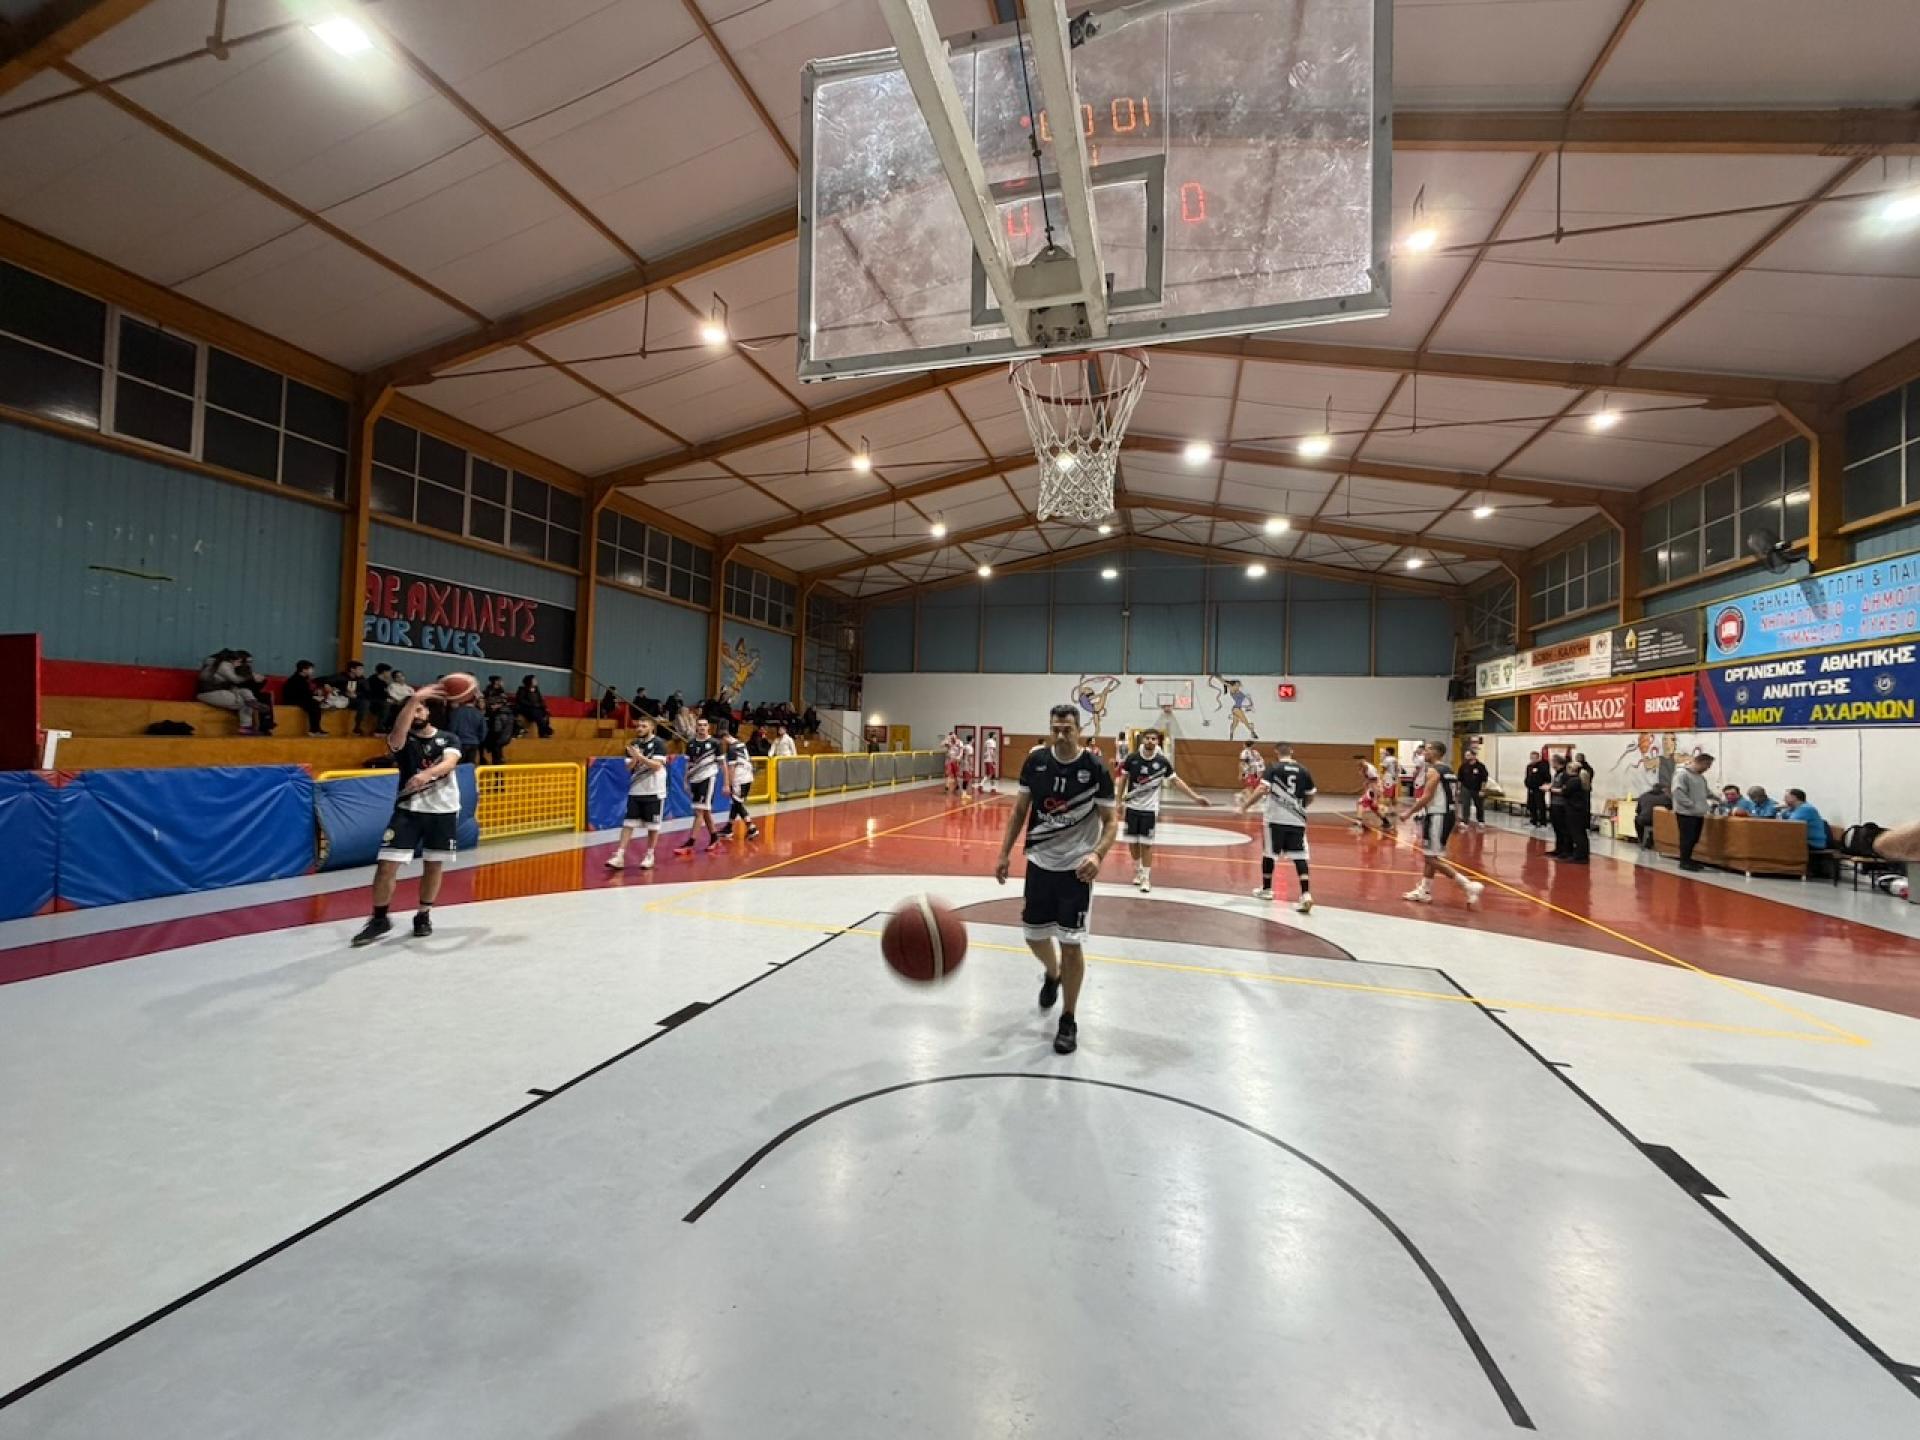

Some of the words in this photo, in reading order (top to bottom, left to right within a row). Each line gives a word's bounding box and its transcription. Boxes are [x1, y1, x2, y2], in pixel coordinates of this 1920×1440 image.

[1872, 569, 1881, 586] &
[363, 614, 413, 648] FOR
[421, 625, 486, 660] EVER
[1724, 659, 1807, 683] ΟΡΓΑΝΙΣΜΟΣ
[1820, 645, 1916, 673] ΑΘΛΗΤΙΚΗΣ
[1762, 677, 1851, 700] ΑΝΑΠΤΥΞΗΣ
[1549, 697, 1626, 721] ΤΗΝΙΑΚΟΣ
[1644, 695, 1681, 714] ΒΙΚΟΣ
[1729, 706, 1785, 724] ΔΗΜΟΥ
[1809, 699, 1915, 721] ΑΧΑΡΝΩΝ
[1052, 776, 1067, 793] 11
